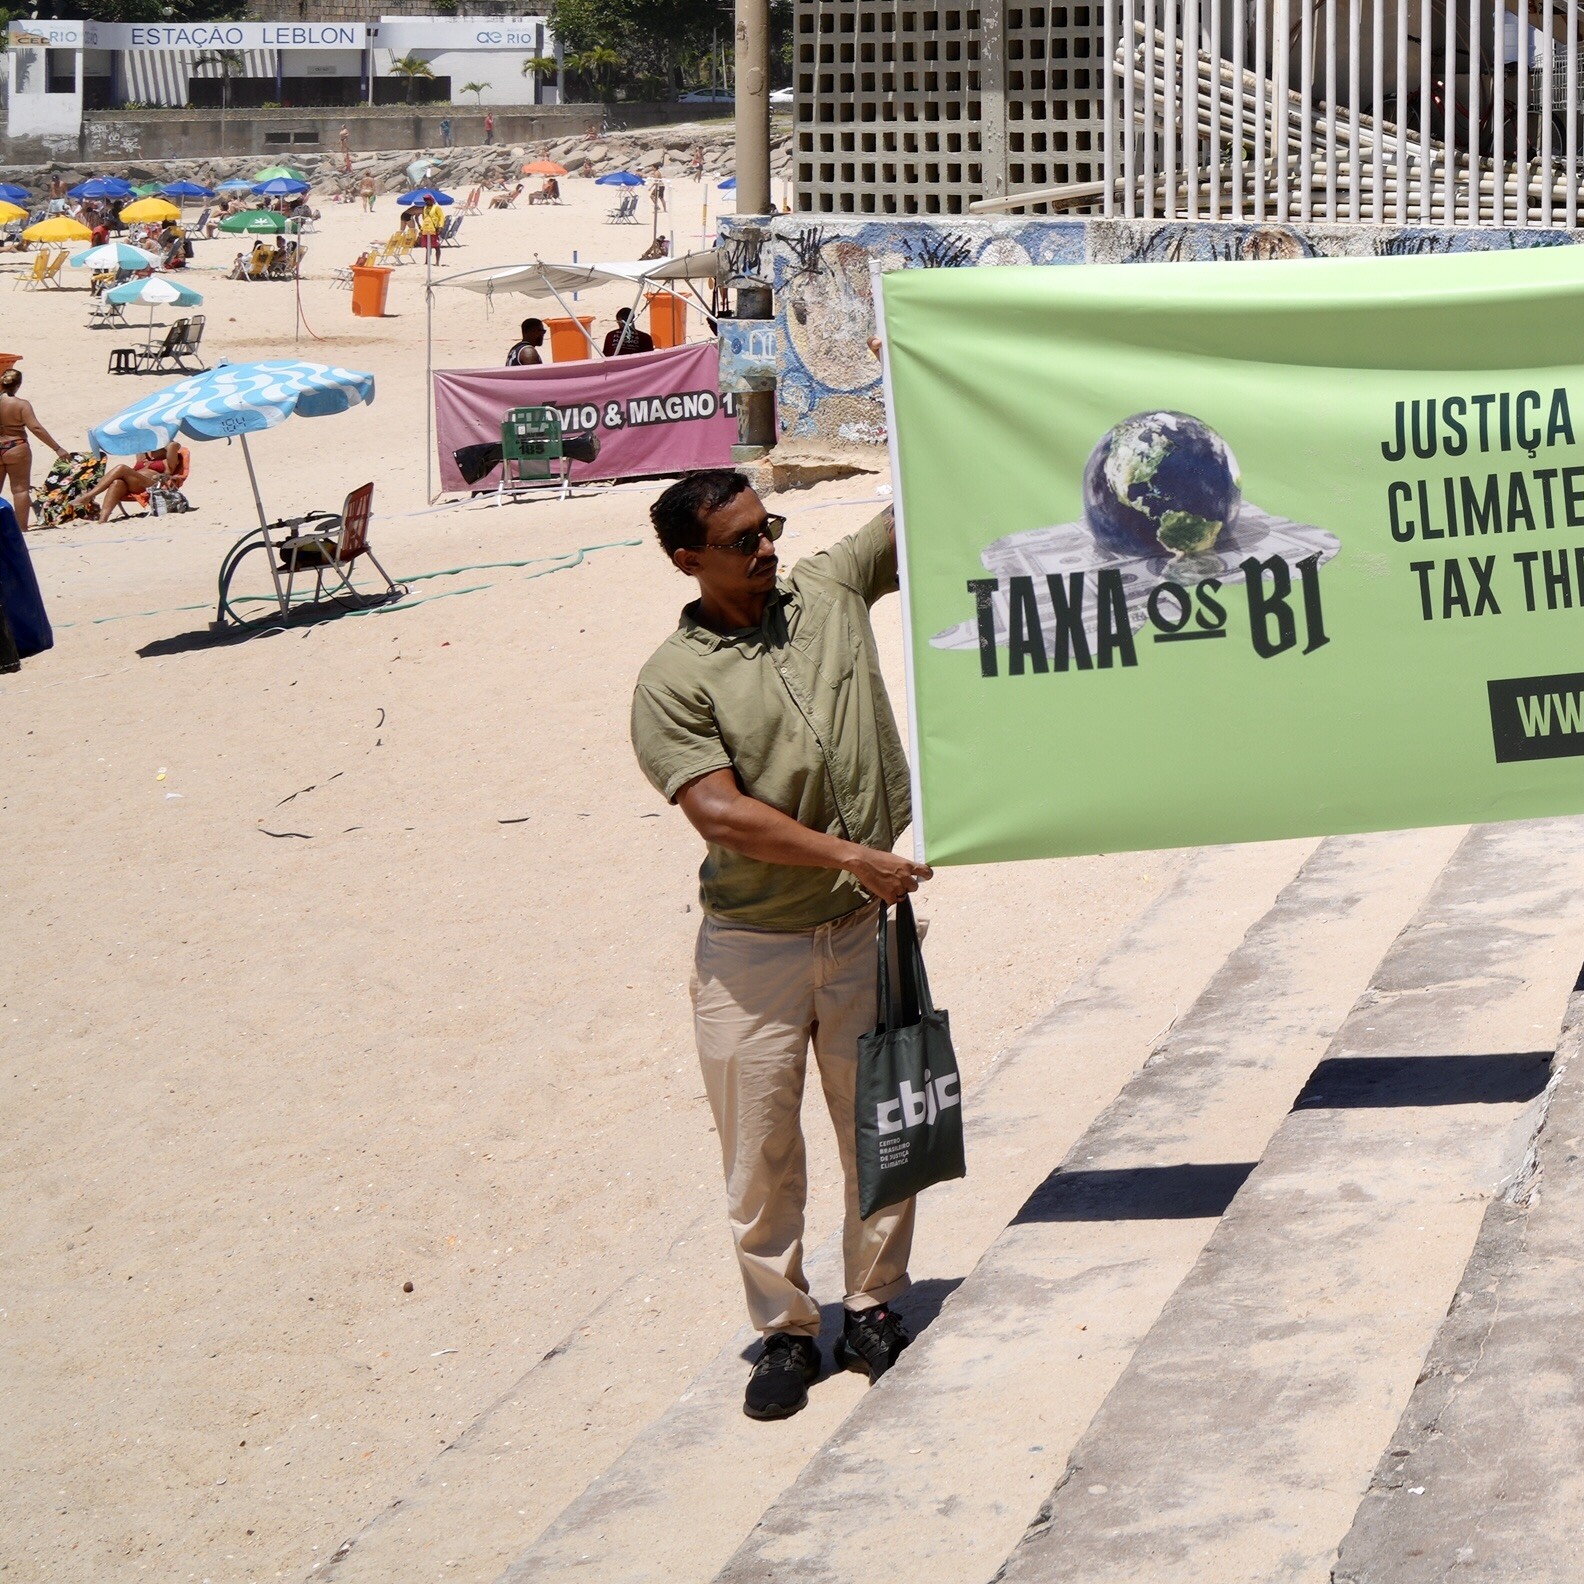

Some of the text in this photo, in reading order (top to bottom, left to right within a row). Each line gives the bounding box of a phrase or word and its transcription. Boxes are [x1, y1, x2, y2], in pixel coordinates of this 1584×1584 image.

[49, 31, 77, 43] RIO
[131, 25, 354, 48] ESTAÇÃO LEBLON
[507, 33, 532, 44] RIO
[605, 403, 622, 425] &
[629, 392, 715, 424] MAGNO
[1381, 387, 1576, 462] JUSTIÇA
[1410, 555, 1502, 621] TAX
[967, 568, 1139, 679] TAXA
[1238, 550, 1331, 660] BI
[876, 1068, 960, 1136] cbjc
